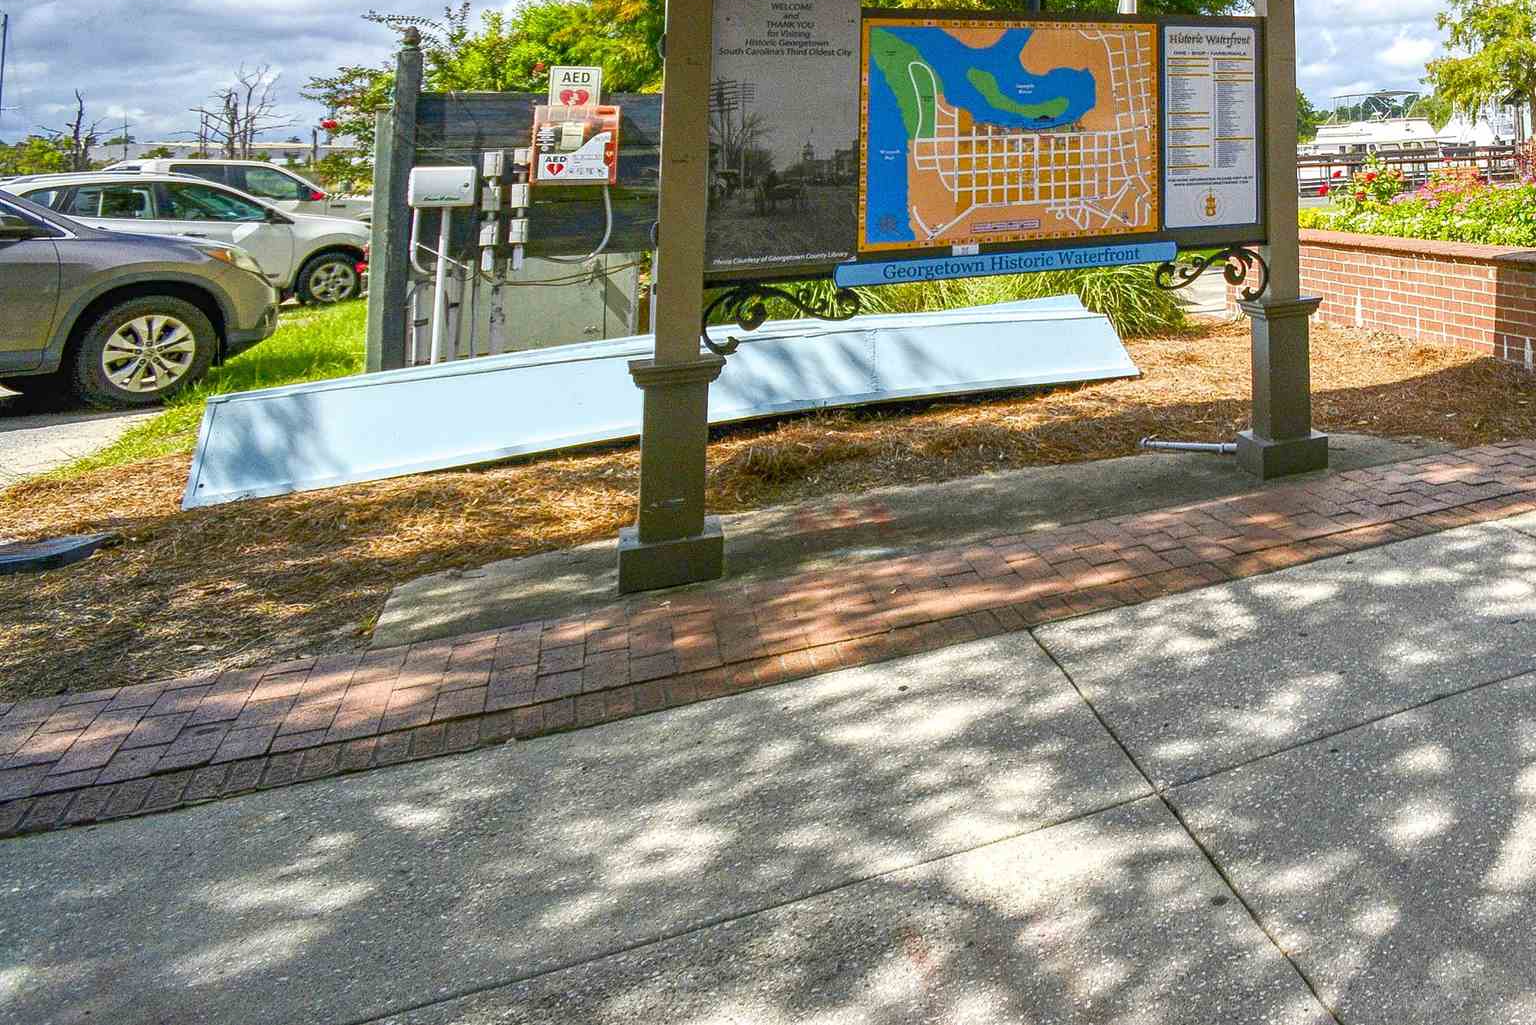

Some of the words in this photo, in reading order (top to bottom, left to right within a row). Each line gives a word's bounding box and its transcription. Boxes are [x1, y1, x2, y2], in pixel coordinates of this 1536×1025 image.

[771, 3, 814, 11] WELCOME
[767, 21, 795, 29] THANK
[797, 21, 815, 29] YOU
[767, 29, 778, 37] for
[780, 29, 811, 39] Visiting
[745, 38, 777, 47] Historic
[779, 39, 829, 48] Georgetown
[1169, 32, 1203, 44] Historic
[1206, 32, 1249, 48] Waterfront
[720, 47, 744, 56] South
[745, 47, 785, 56] Carolina's
[786, 47, 808, 56] Third
[810, 47, 835, 56] Oldest
[837, 48, 852, 57] City
[562, 72, 590, 83] AED
[768, 254, 806, 263] Georgetown
[806, 252, 827, 261] County
[828, 251, 848, 259] Library
[883, 261, 984, 280] Georgetown
[991, 253, 1054, 272] Historic
[1057, 247, 1140, 265] Waterfront
